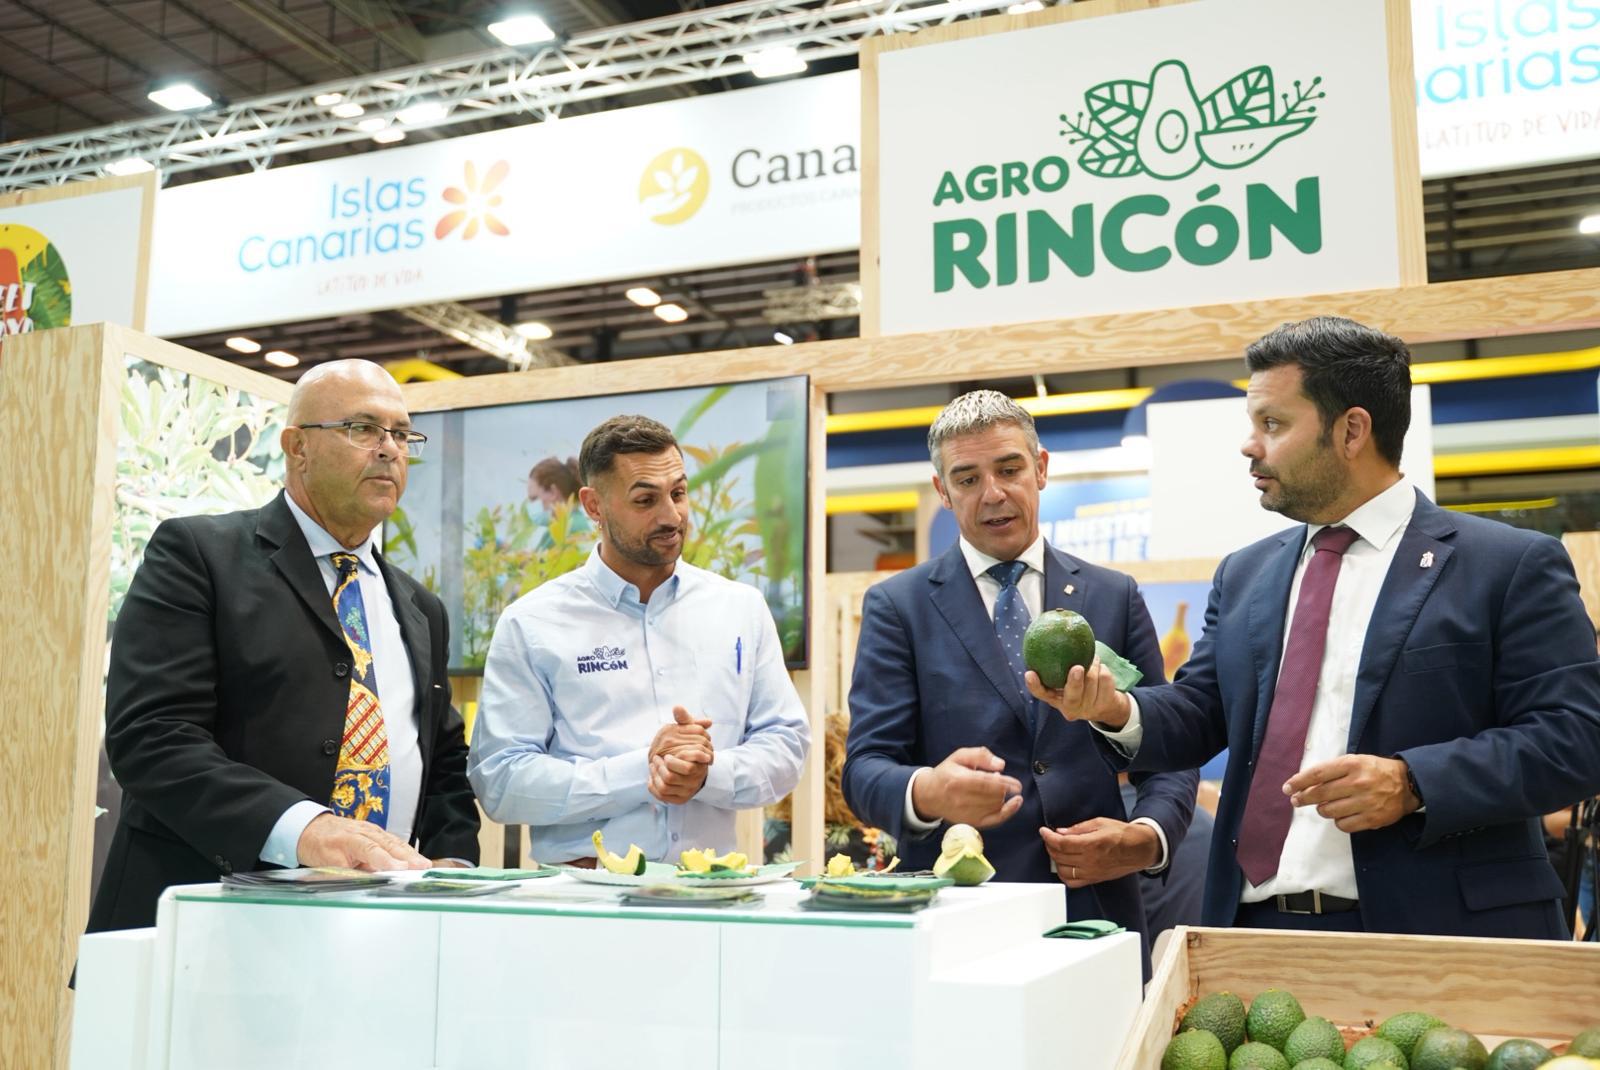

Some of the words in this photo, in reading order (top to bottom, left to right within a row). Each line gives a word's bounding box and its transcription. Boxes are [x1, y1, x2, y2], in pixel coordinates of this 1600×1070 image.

[1436, 0, 1600, 51] Islas
[1416, 44, 1600, 107] arias
[331, 176, 426, 219] Islas
[932, 155, 1070, 207] AGRO
[238, 217, 425, 272] Canarias
